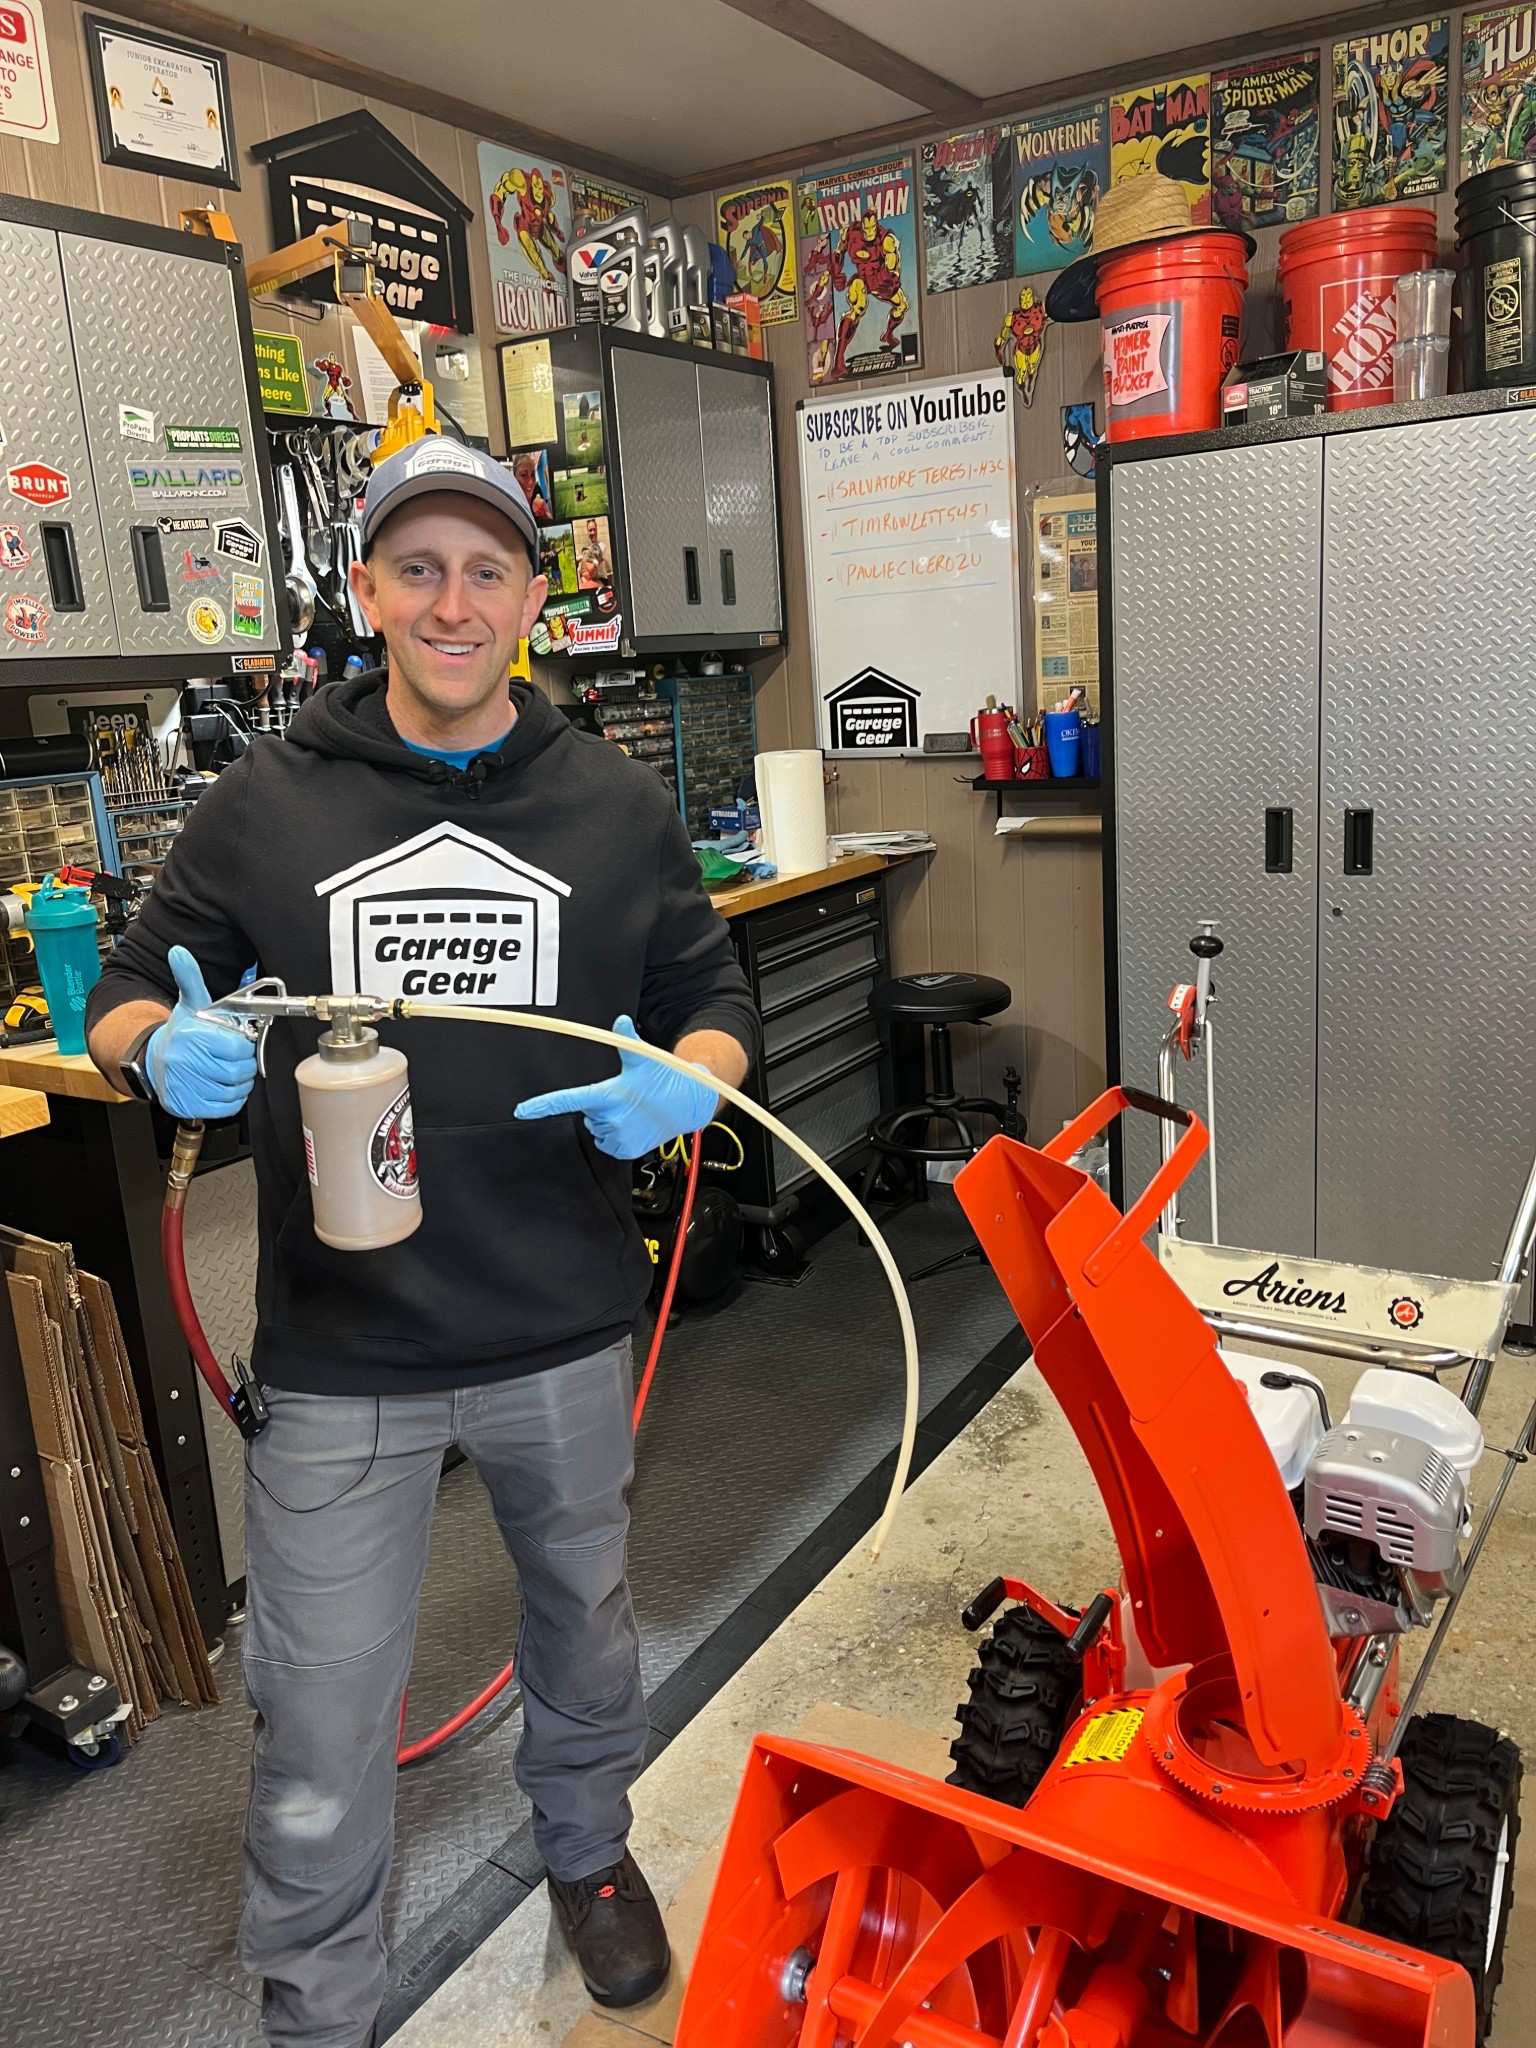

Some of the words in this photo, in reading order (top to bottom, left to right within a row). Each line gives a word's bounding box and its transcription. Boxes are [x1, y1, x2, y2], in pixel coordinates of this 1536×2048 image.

[1483, 9, 1510, 19] MARVEL
[1349, 24, 1428, 66] THOR
[127, 50, 152, 64] JUNIOR
[153, 58, 193, 75] EXCAVATOR
[144, 64, 178, 79] OPERATOR
[1242, 66, 1295, 88] AMAZING
[1016, 118, 1100, 166] WOLVERINE
[818, 175, 845, 187] MARVEL
[848, 168, 876, 181] COMICS
[878, 161, 903, 174] GROUP
[821, 188, 840, 198] THE
[843, 170, 903, 193] INVINCIBLE
[1403, 180, 1440, 195] GALACTUS!
[721, 188, 789, 232] SUPERMAN
[816, 198, 862, 233] IRON
[867, 185, 910, 221] MAN
[503, 269, 519, 282] THE
[523, 274, 568, 294] INVINCIBLE
[497, 281, 541, 331] IRON
[726, 295, 744, 304] FRAM
[1331, 289, 1380, 339] THE
[1114, 329, 1151, 360] HOMER
[275, 366, 300, 383] Like
[852, 360, 896, 374] HAMMER!
[1116, 350, 1148, 376] PAINT
[1112, 371, 1154, 396] BUCKET
[1249, 385, 1273, 396] TRACTION
[806, 403, 882, 443] SUBSCRIBE
[887, 398, 909, 431] ON
[910, 383, 1007, 425] YouTube
[818, 446, 831, 460] TO
[839, 440, 854, 454] BE
[877, 434, 898, 446] TOP
[824, 454, 861, 473] LEAVE
[872, 451, 880, 462] A
[889, 444, 919, 457] COOL
[10, 474, 69, 495] BRUNT
[129, 467, 243, 487] BALLARD
[13, 598, 44, 612] IMPELLER
[10, 625, 44, 639] POWERED
[244, 658, 273, 667] GLADIATOR
[88, 710, 139, 733] Jeep
[844, 716, 903, 732] Garage
[854, 731, 894, 747] Gear
[374, 935, 522, 965] Garage
[64, 963, 76, 996] Blender
[74, 969, 85, 995] Bottle
[401, 968, 497, 996] Gear
[377, 1110, 397, 1138] LAKE
[1222, 1261, 1348, 1314] Ariens
[1249, 1303, 1273, 1312] COMPANY
[1297, 1310, 1325, 1320] WISCONSIN
[1112, 1713, 1141, 1755] CAUTION
